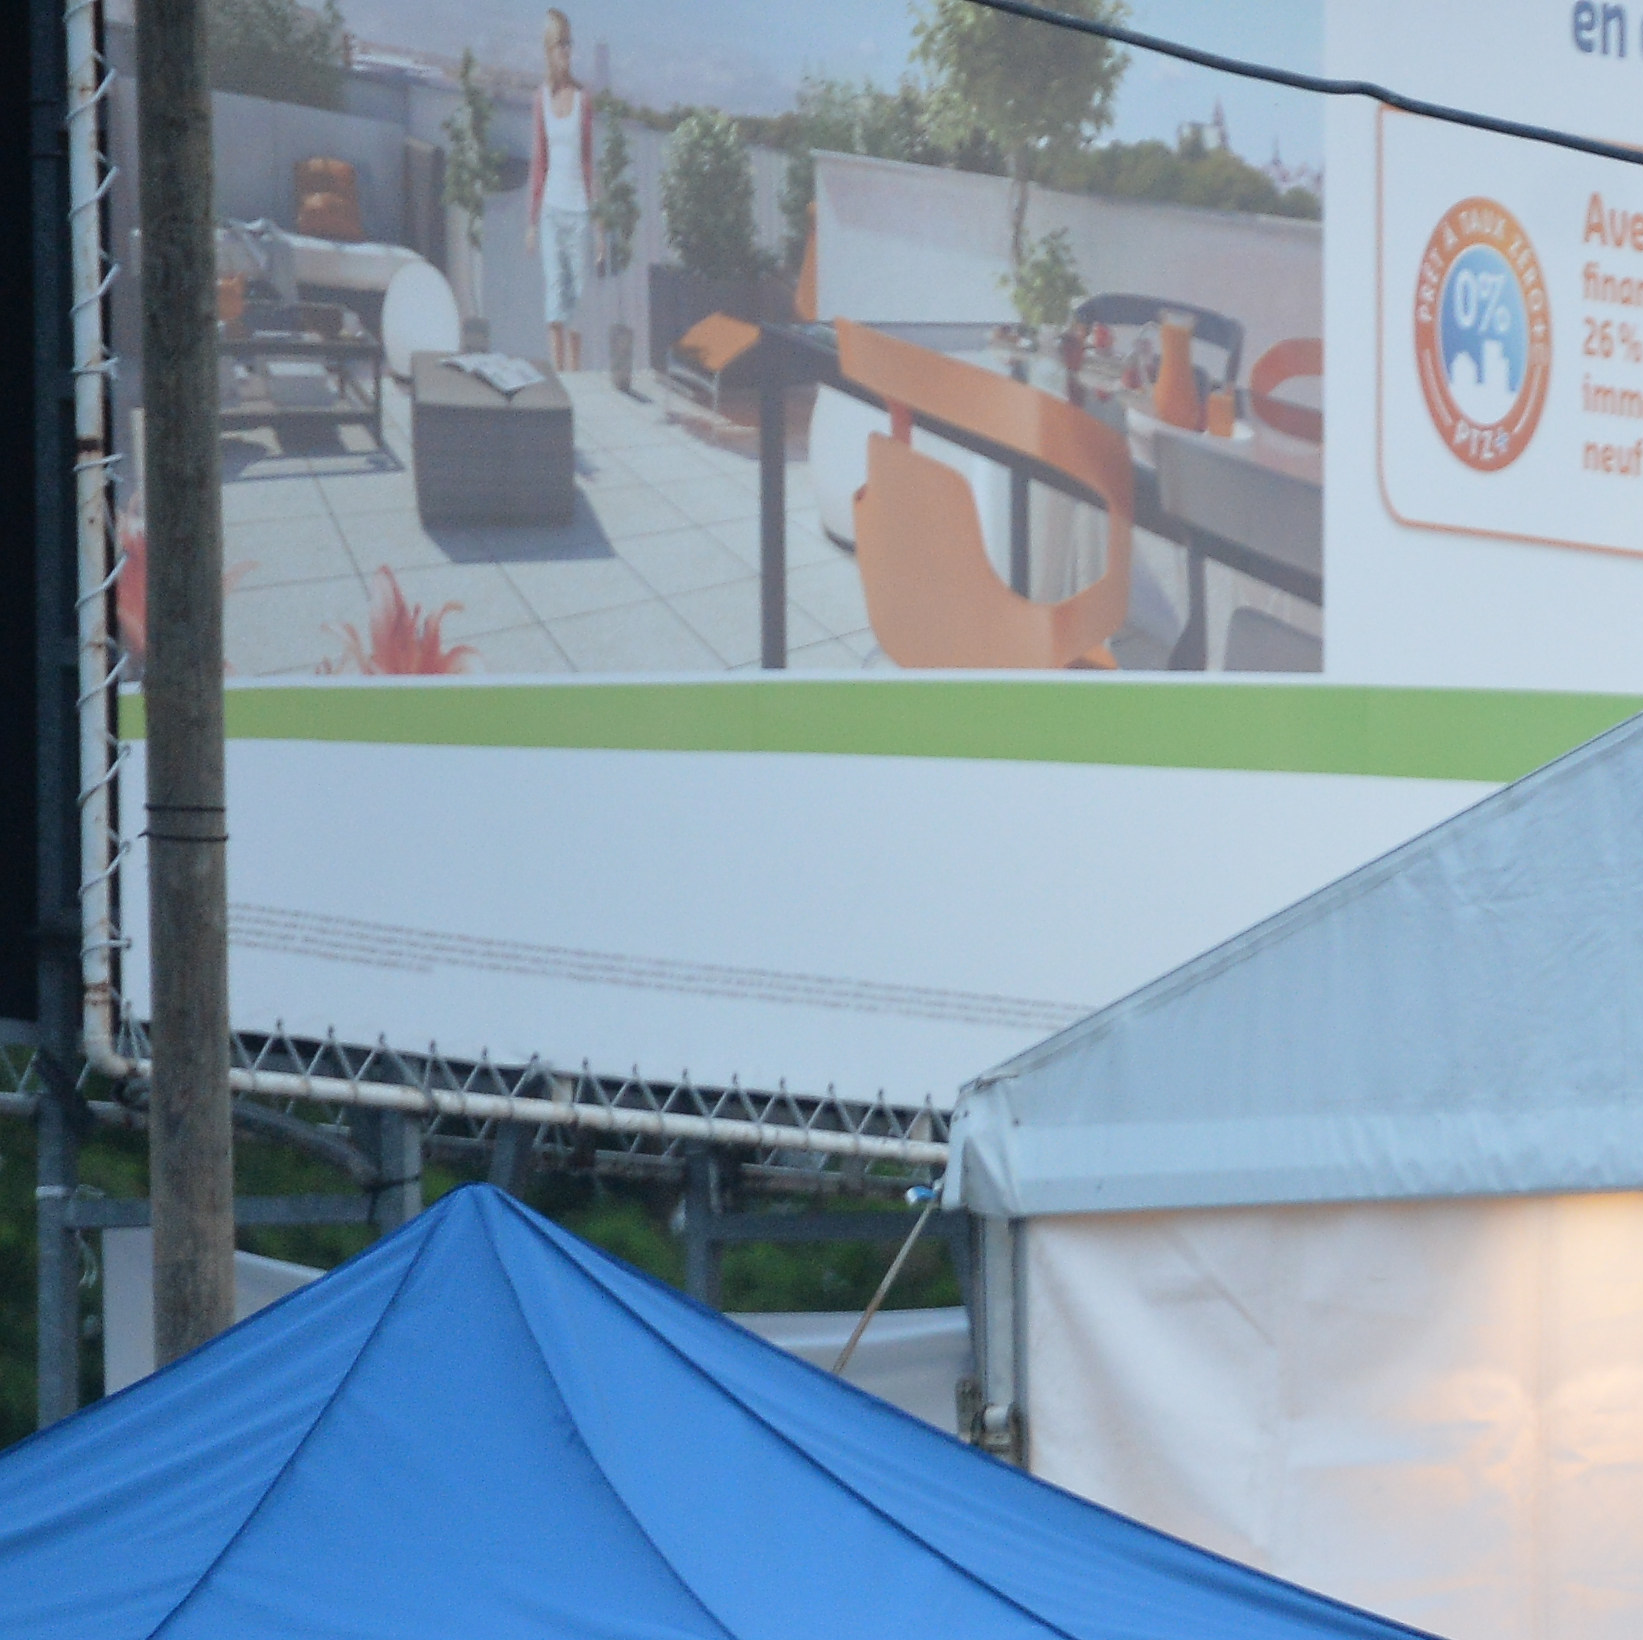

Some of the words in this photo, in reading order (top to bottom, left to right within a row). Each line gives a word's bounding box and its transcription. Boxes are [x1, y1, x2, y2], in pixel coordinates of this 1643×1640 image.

[1572, 0, 1628, 58] en
[1455, 267, 1512, 334] 0%
[1584, 315, 1615, 358] 26
